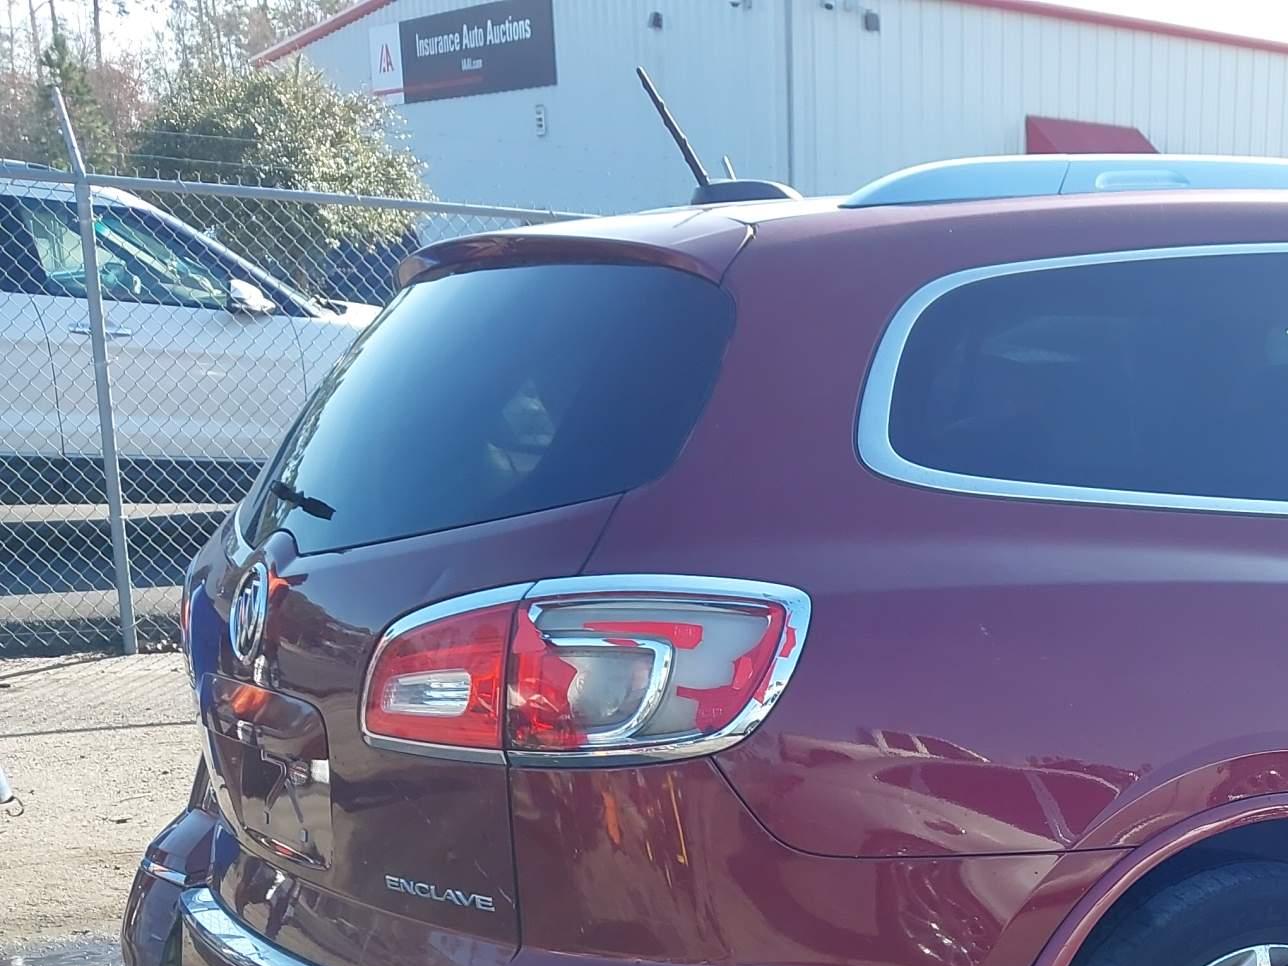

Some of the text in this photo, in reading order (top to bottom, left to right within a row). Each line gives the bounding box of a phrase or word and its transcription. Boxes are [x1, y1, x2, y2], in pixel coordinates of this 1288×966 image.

[415, 16, 532, 57] Insurance Auto Auctions
[384, 874, 496, 912] ENCLAVE
